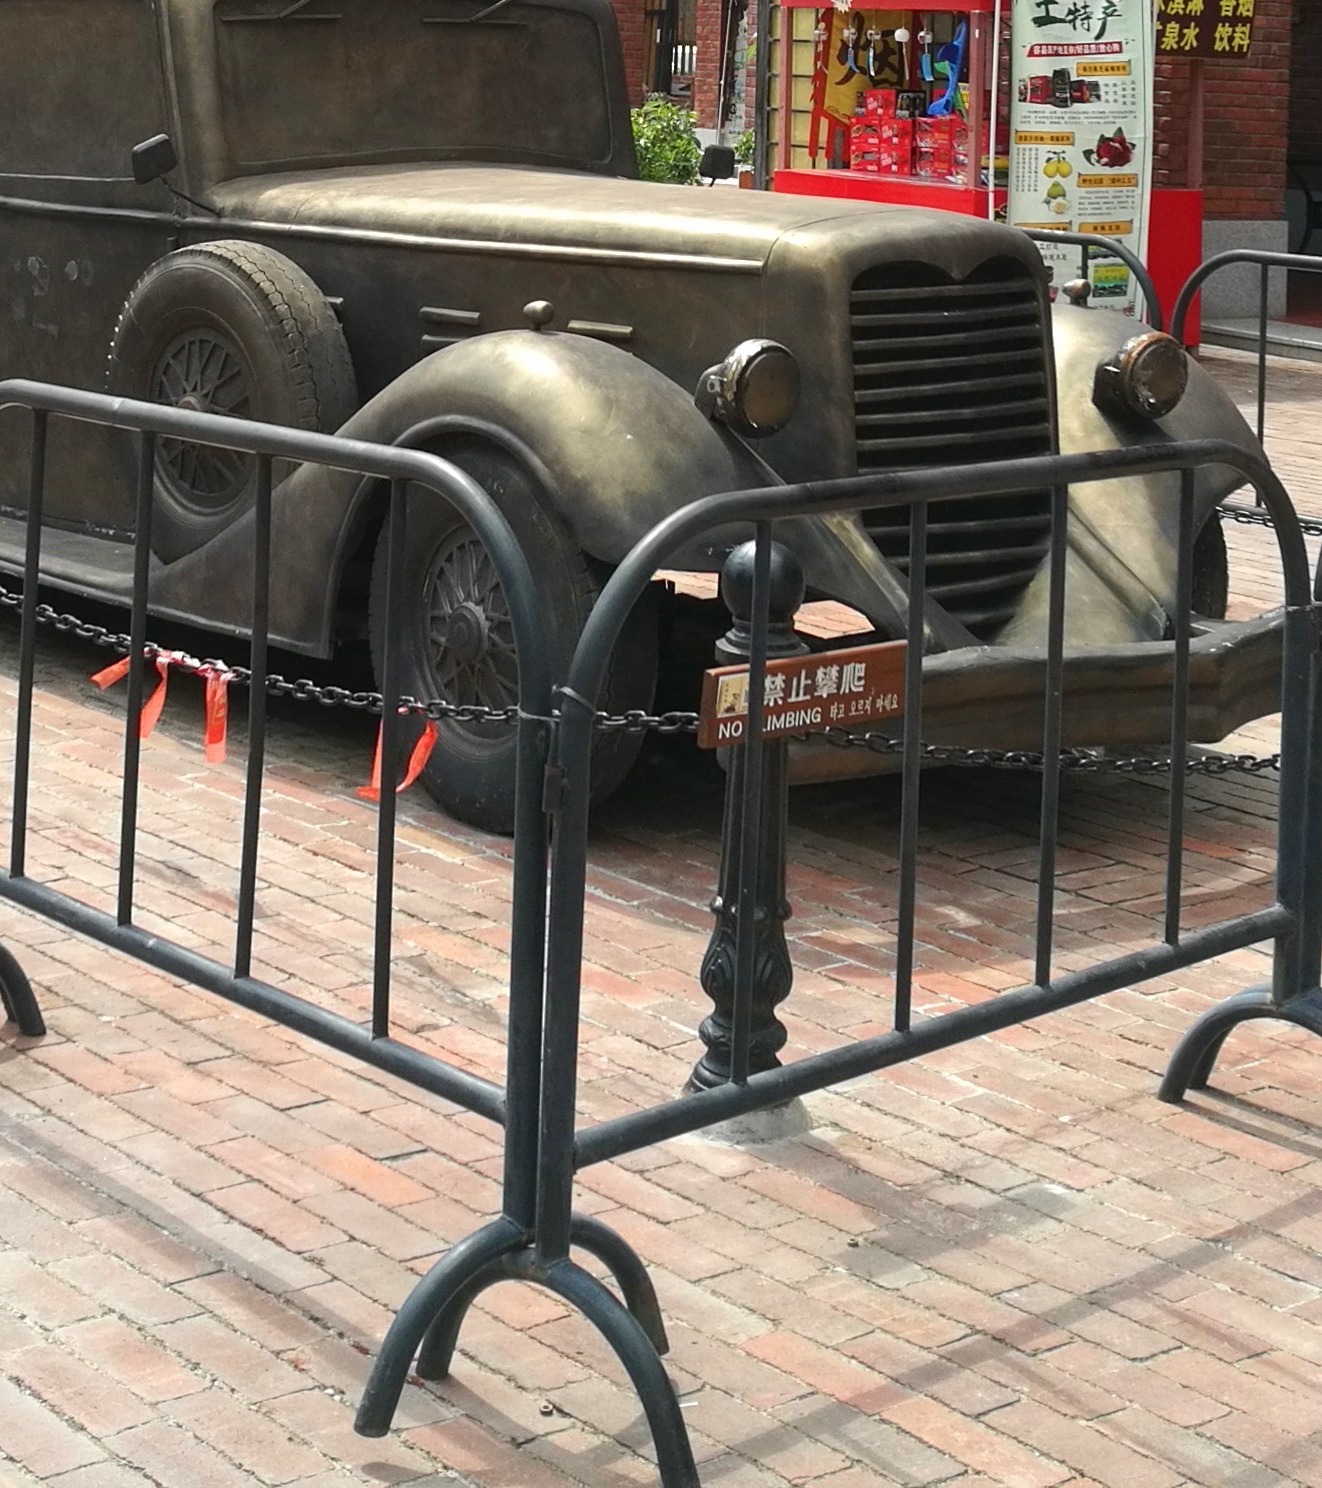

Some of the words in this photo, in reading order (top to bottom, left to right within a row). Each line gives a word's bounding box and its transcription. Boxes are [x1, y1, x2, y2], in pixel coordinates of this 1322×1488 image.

[1156, 21, 1200, 51] 泉水
[1214, 23, 1250, 53] 饮料
[763, 662, 866, 707] 禁止攀爬
[718, 720, 743, 739] NO
[763, 706, 822, 732] IMBING
